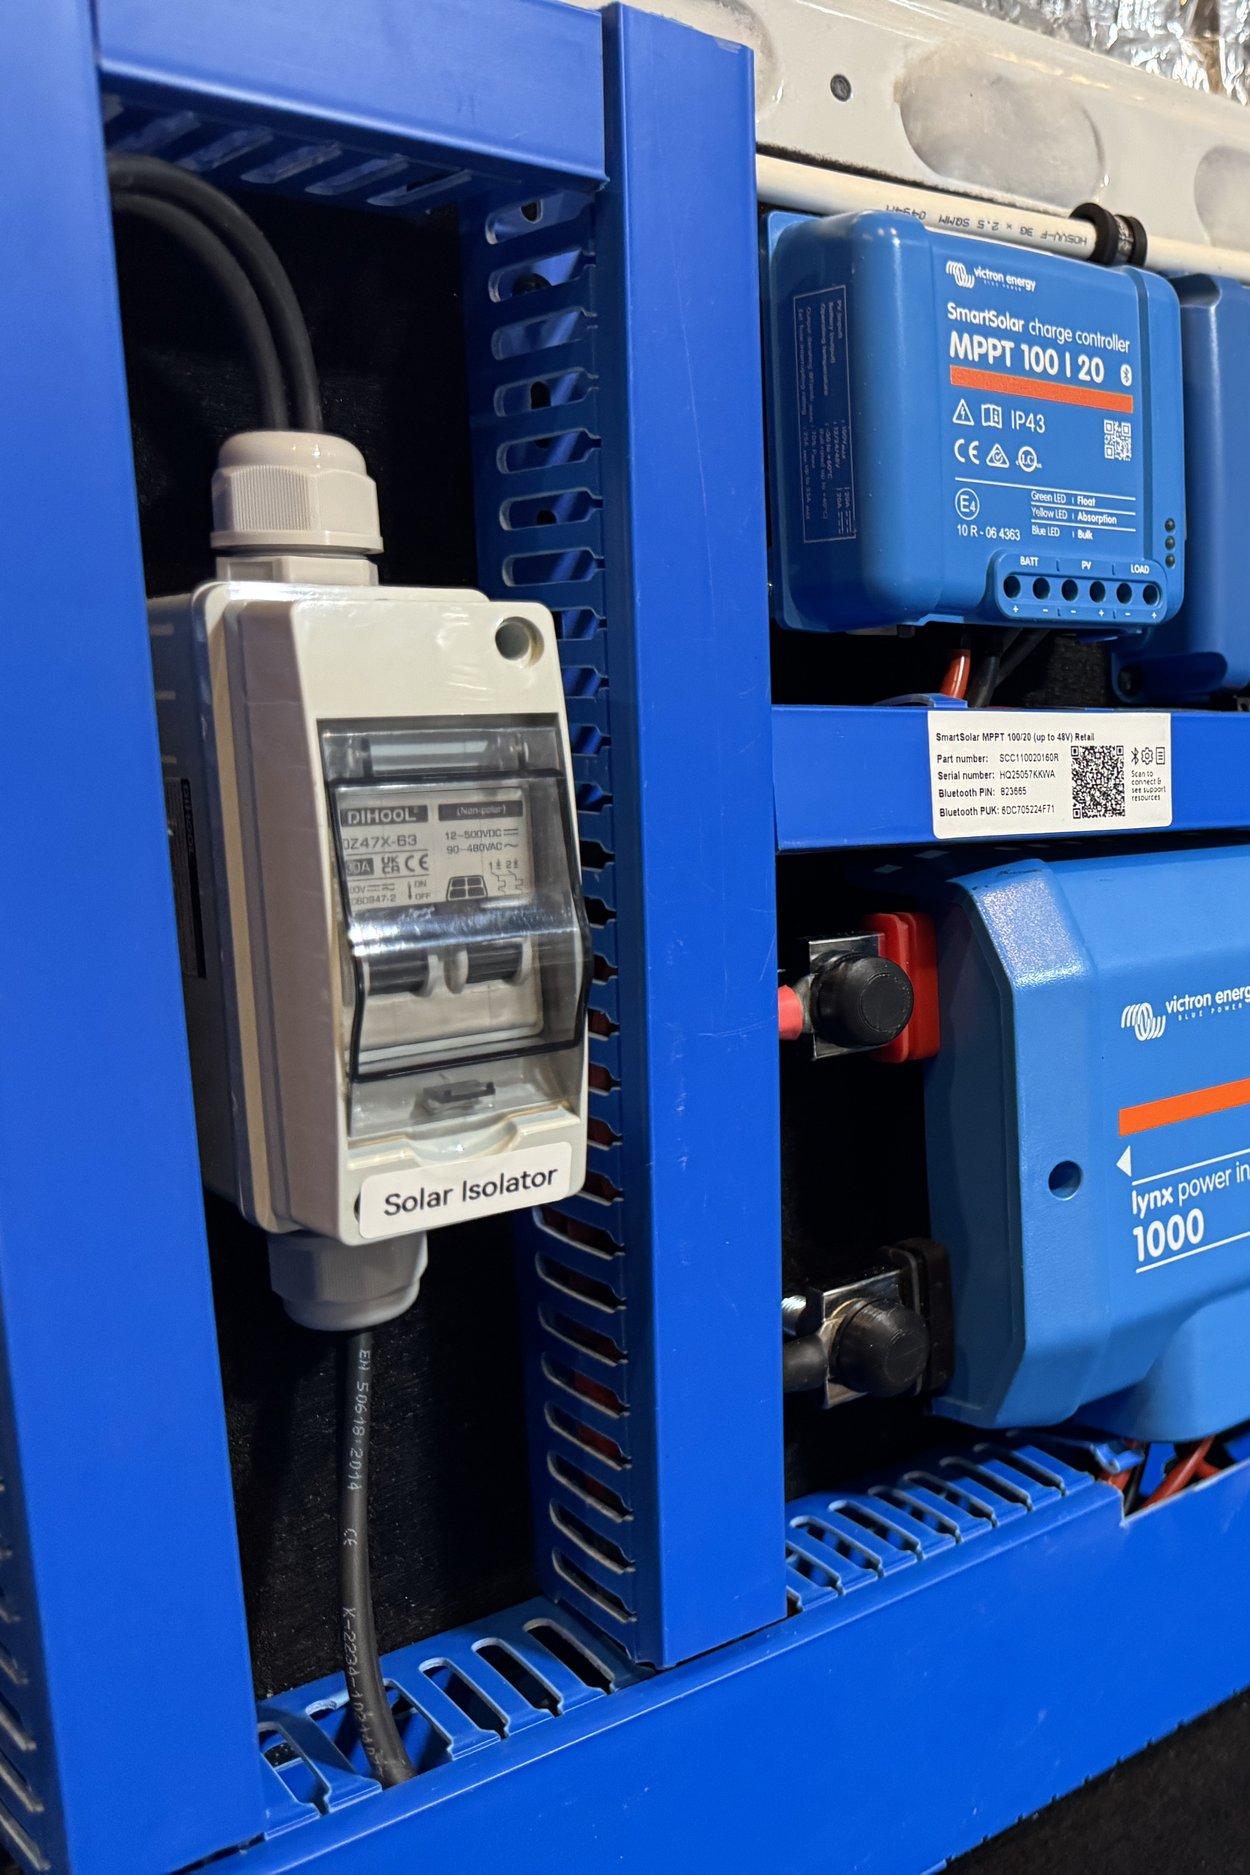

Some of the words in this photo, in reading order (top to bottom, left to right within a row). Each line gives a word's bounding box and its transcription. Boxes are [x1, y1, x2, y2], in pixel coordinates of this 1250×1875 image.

[938, 215, 970, 228] SQMM
[977, 219, 999, 231] 2.5
[1020, 227, 1033, 238] 3G
[973, 265, 1004, 283] victron
[1006, 274, 1036, 292] energy
[947, 301, 1025, 333] SmartSolar
[1028, 318, 1073, 345] charge
[1075, 330, 1131, 354] controller
[949, 330, 1015, 369] MPPT
[1020, 343, 1059, 376] 100
[1077, 354, 1105, 384] 20
[1010, 409, 1046, 434] IP43
[1031, 490, 1054, 502] Green
[1054, 493, 1067, 504] LED
[1077, 495, 1097, 507] Float
[1031, 507, 1054, 519] Yellow
[1055, 509, 1068, 520] LED
[1077, 512, 1118, 526] Absorption
[957, 524, 969, 537] 10
[970, 525, 978, 537] R
[985, 526, 998, 539] 06
[999, 527, 1021, 541] 4363
[1031, 525, 1047, 536] Blue
[1047, 527, 1060, 538] LED
[1077, 529, 1093, 541] Bulk
[1020, 556, 1039, 567] BATT
[1081, 561, 1092, 571] PV
[1130, 563, 1150, 575] LOAD
[936, 732, 980, 742] SmartSolar
[982, 732, 1004, 742] MPPT
[1007, 732, 1032, 742] 100/20
[1033, 732, 1046, 743] (up
[1047, 733, 1055, 741] to
[1057, 732, 1073, 743] 48V)
[1074, 732, 1095, 742] Retail
[936, 754, 953, 764] Part
[955, 754, 989, 764] number:
[938, 771, 960, 781] Serial
[962, 770, 995, 780] number:
[938, 788, 977, 798] Bluetooth
[979, 788, 996, 797] PIN:
[347, 807, 417, 825] DIHOOL
[939, 806, 978, 817] Bluetooth
[980, 806, 1000, 816] PUK:
[1165, 993, 1212, 1014] victron
[1178, 1009, 1203, 1021] BLUE
[1211, 1002, 1242, 1014] POWER
[383, 1187, 454, 1217] Solar
[462, 1167, 558, 1203] Isolator
[1131, 1184, 1174, 1220] lynx
[1178, 1169, 1231, 1207] power
[1236, 1160, 1250, 1185] in
[1132, 1208, 1205, 1263] 1000
